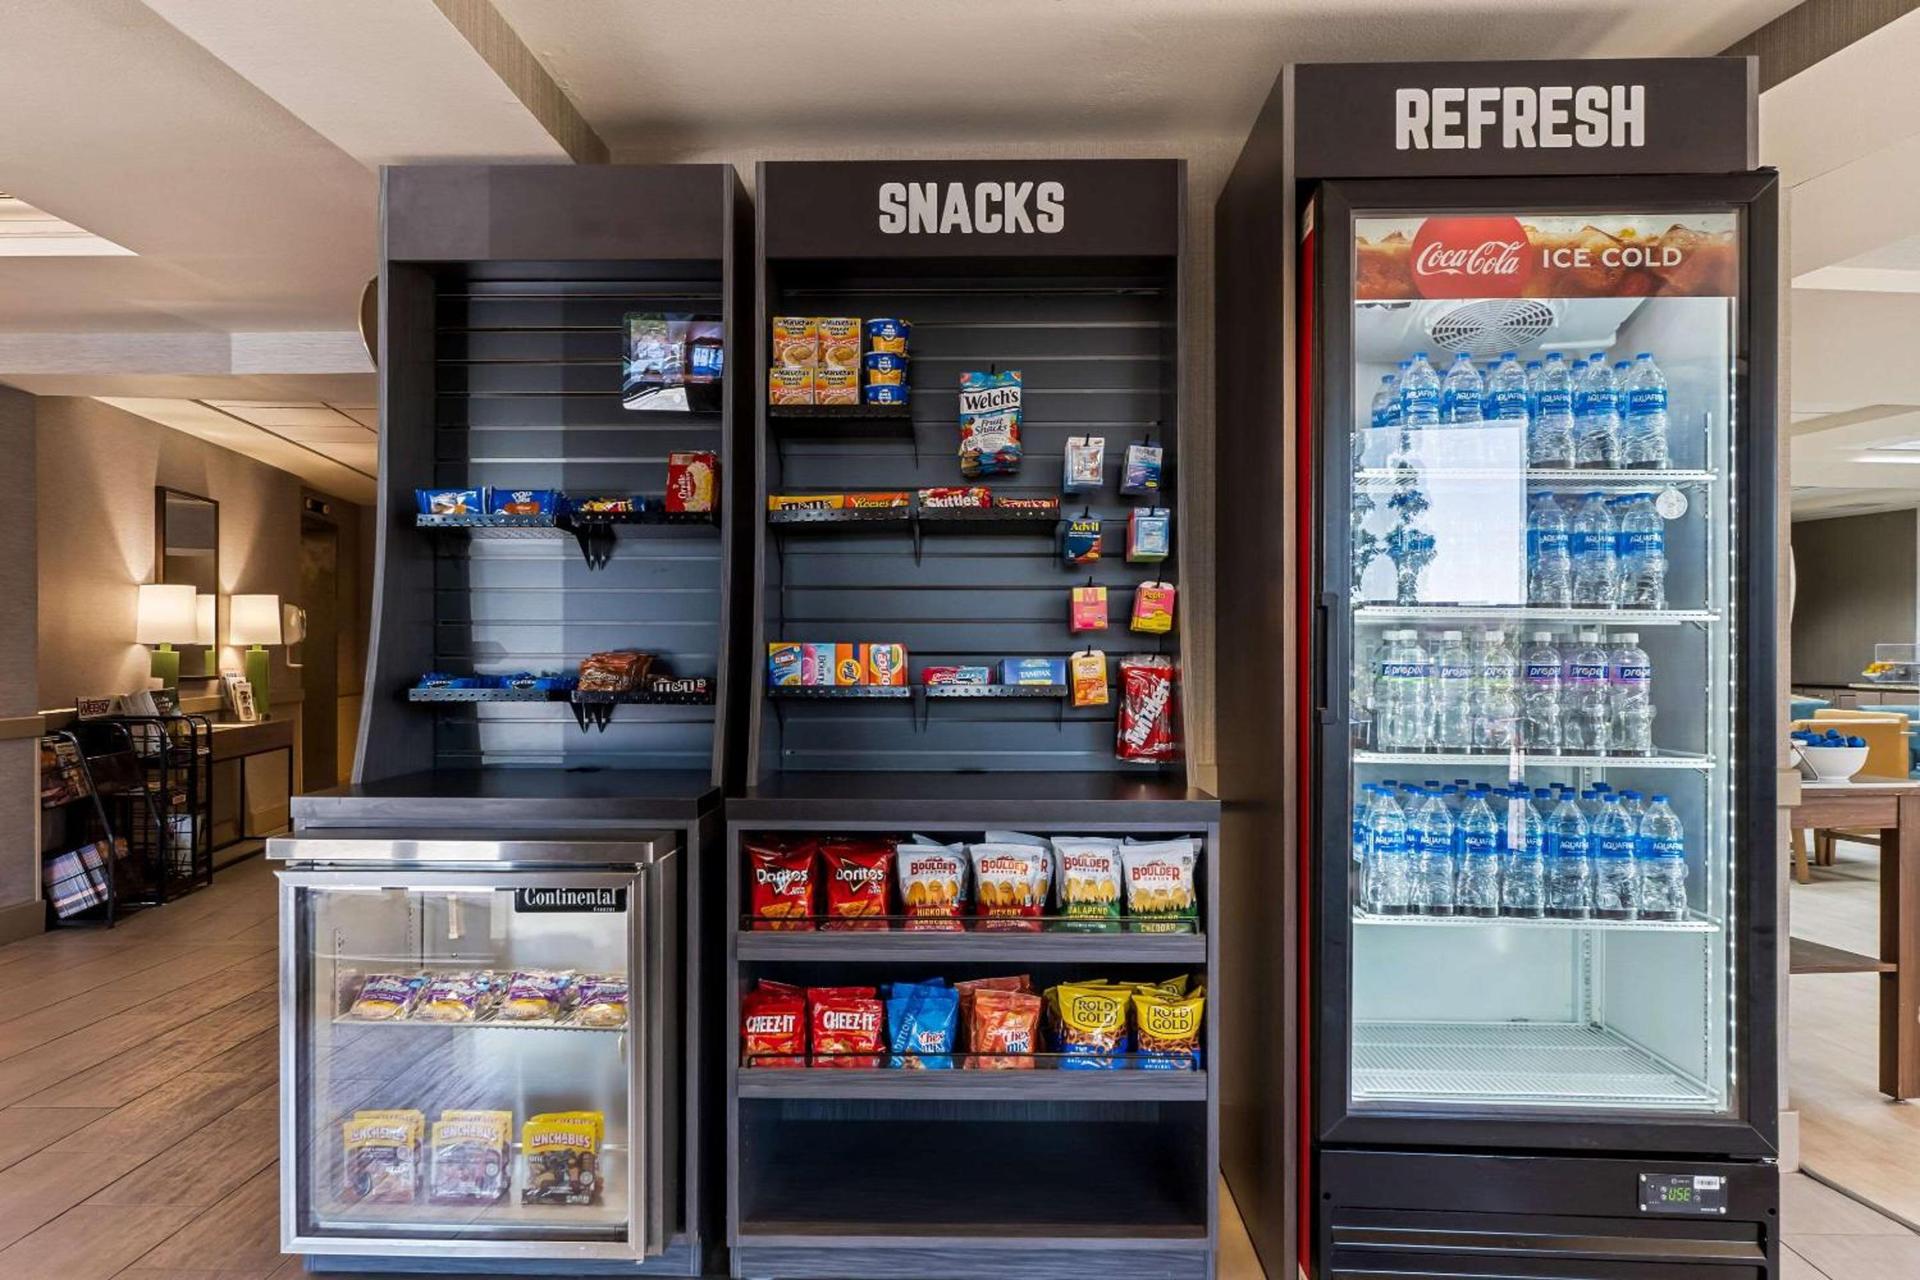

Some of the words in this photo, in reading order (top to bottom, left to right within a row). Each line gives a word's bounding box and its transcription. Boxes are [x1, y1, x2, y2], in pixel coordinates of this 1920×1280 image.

[1396, 86, 1645, 150] REFRESH
[879, 182, 1065, 234] SNACKS
[1543, 248, 1590, 268] ICE
[1602, 247, 1682, 268] COLD
[965, 390, 1019, 411] Welch's
[1070, 521, 1099, 532] Advil
[911, 862, 957, 876] BOULDER
[981, 859, 1028, 876] BOULDER
[1064, 857, 1110, 873] BOULDER
[756, 868, 808, 883] Doritos
[836, 867, 884, 880] Doritos
[1132, 867, 1180, 881] BOULDER
[524, 888, 616, 906] Continental
[1079, 1000, 1113, 1011] ROLD
[1078, 1011, 1115, 1022] GOLD
[1153, 1008, 1189, 1018] ROLD
[746, 1014, 796, 1032] CHEEZ-IT
[823, 1011, 875, 1031] CHEEZ-IT
[1152, 1018, 1189, 1029] GOLD
[920, 1031, 946, 1043] Chex
[1004, 1031, 1029, 1043] Chex
[1006, 1042, 1029, 1053] mix
[531, 1133, 591, 1148] LUNCHABLES
[1668, 1187, 1691, 1201] USE
